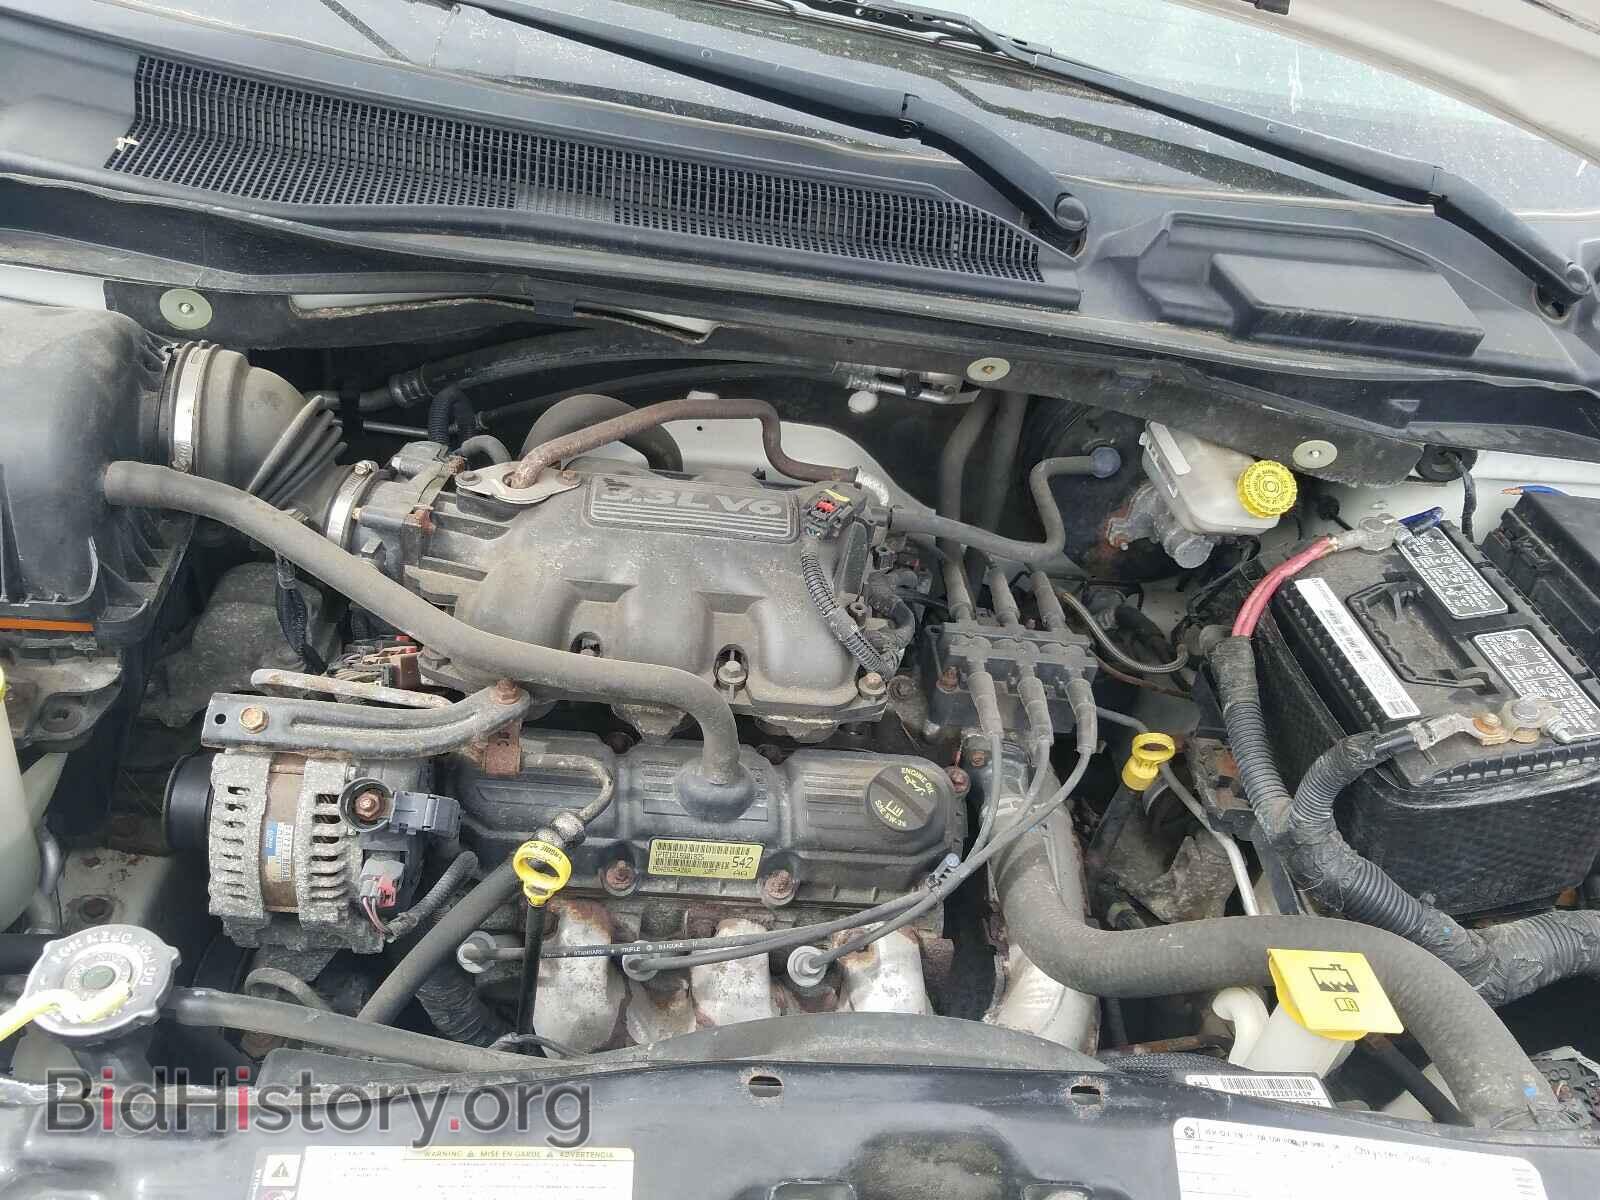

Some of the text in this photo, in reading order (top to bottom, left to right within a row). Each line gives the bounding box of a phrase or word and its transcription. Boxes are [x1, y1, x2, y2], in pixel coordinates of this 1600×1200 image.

[716, 494, 783, 515] V6
[901, 767, 935, 795] ENGINE OIL
[732, 856, 754, 869] 542
